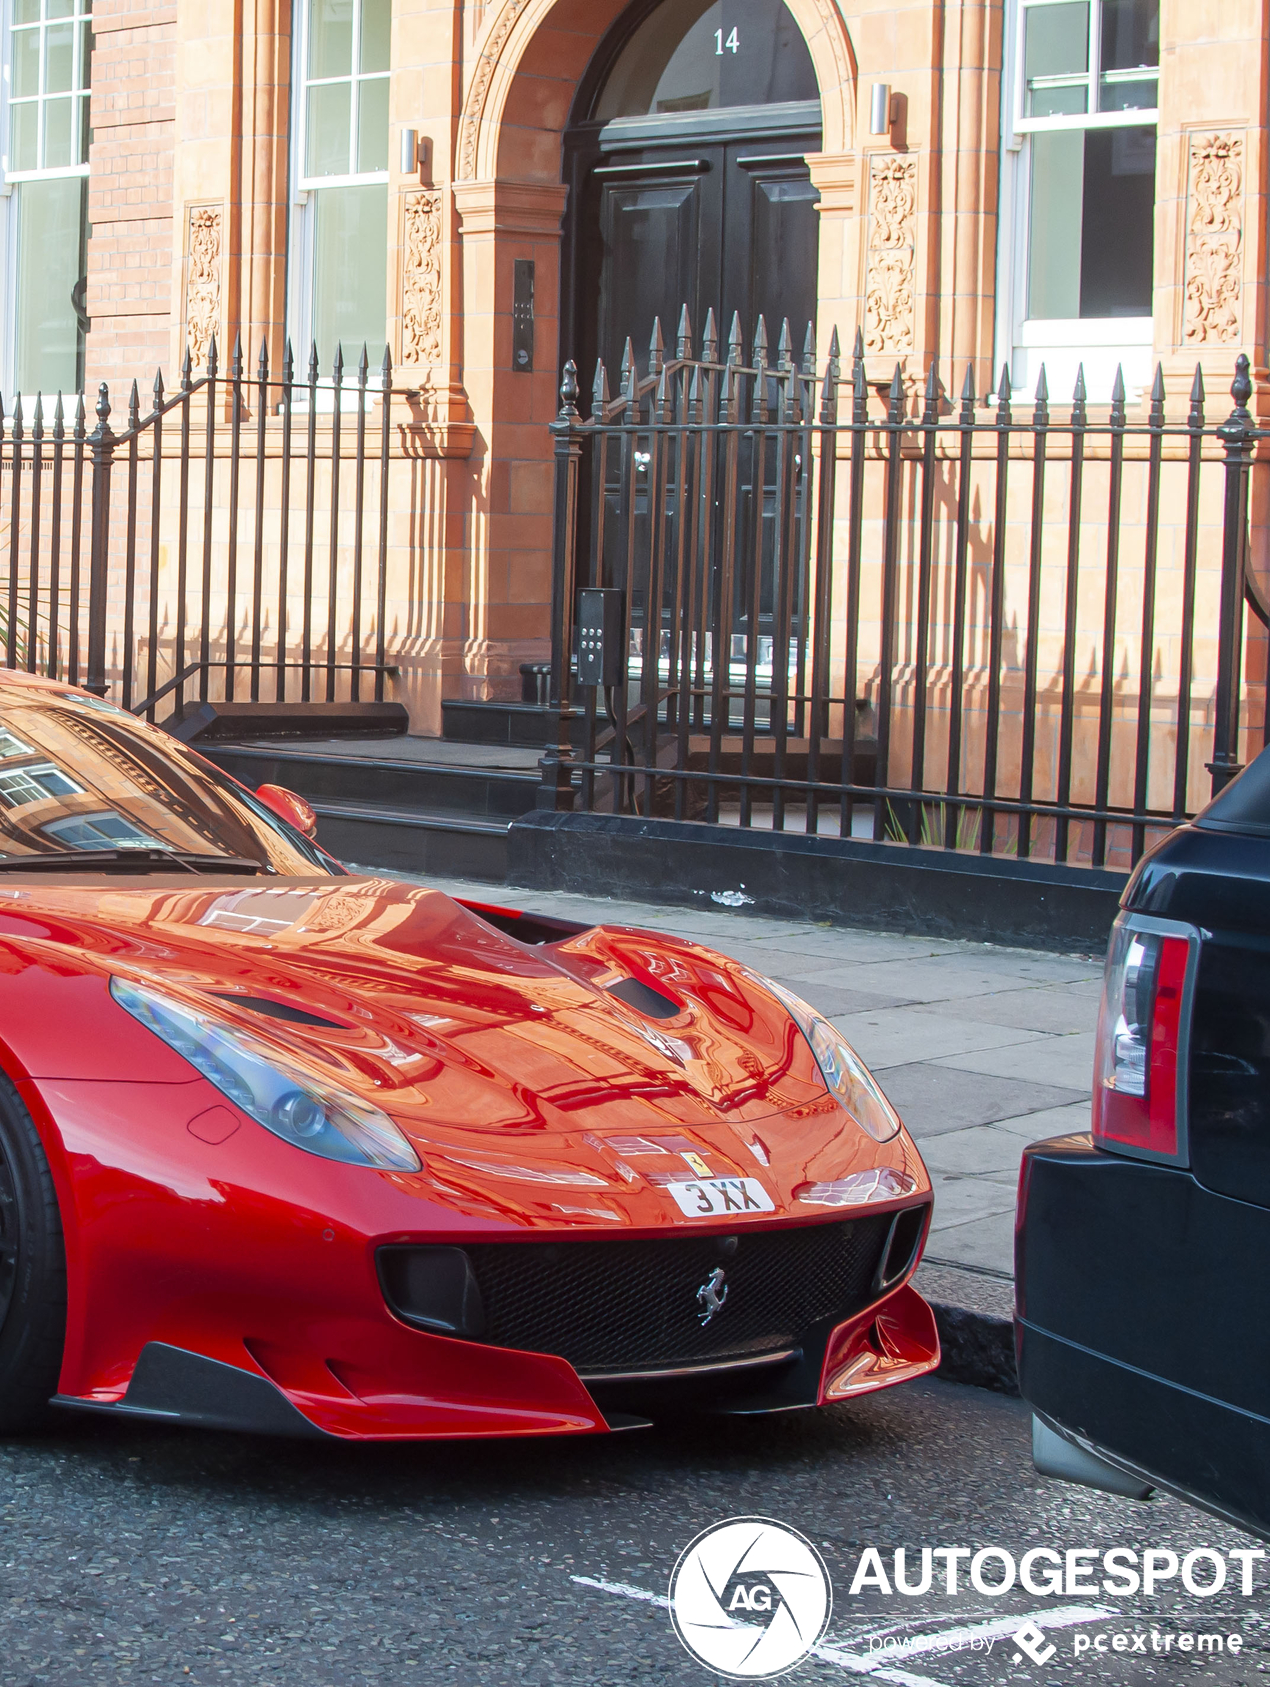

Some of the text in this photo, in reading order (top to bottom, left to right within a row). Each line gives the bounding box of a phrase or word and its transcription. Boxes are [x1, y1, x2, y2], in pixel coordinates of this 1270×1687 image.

[714, 26, 740, 55] 14
[685, 1181, 762, 1213] 3 XX
